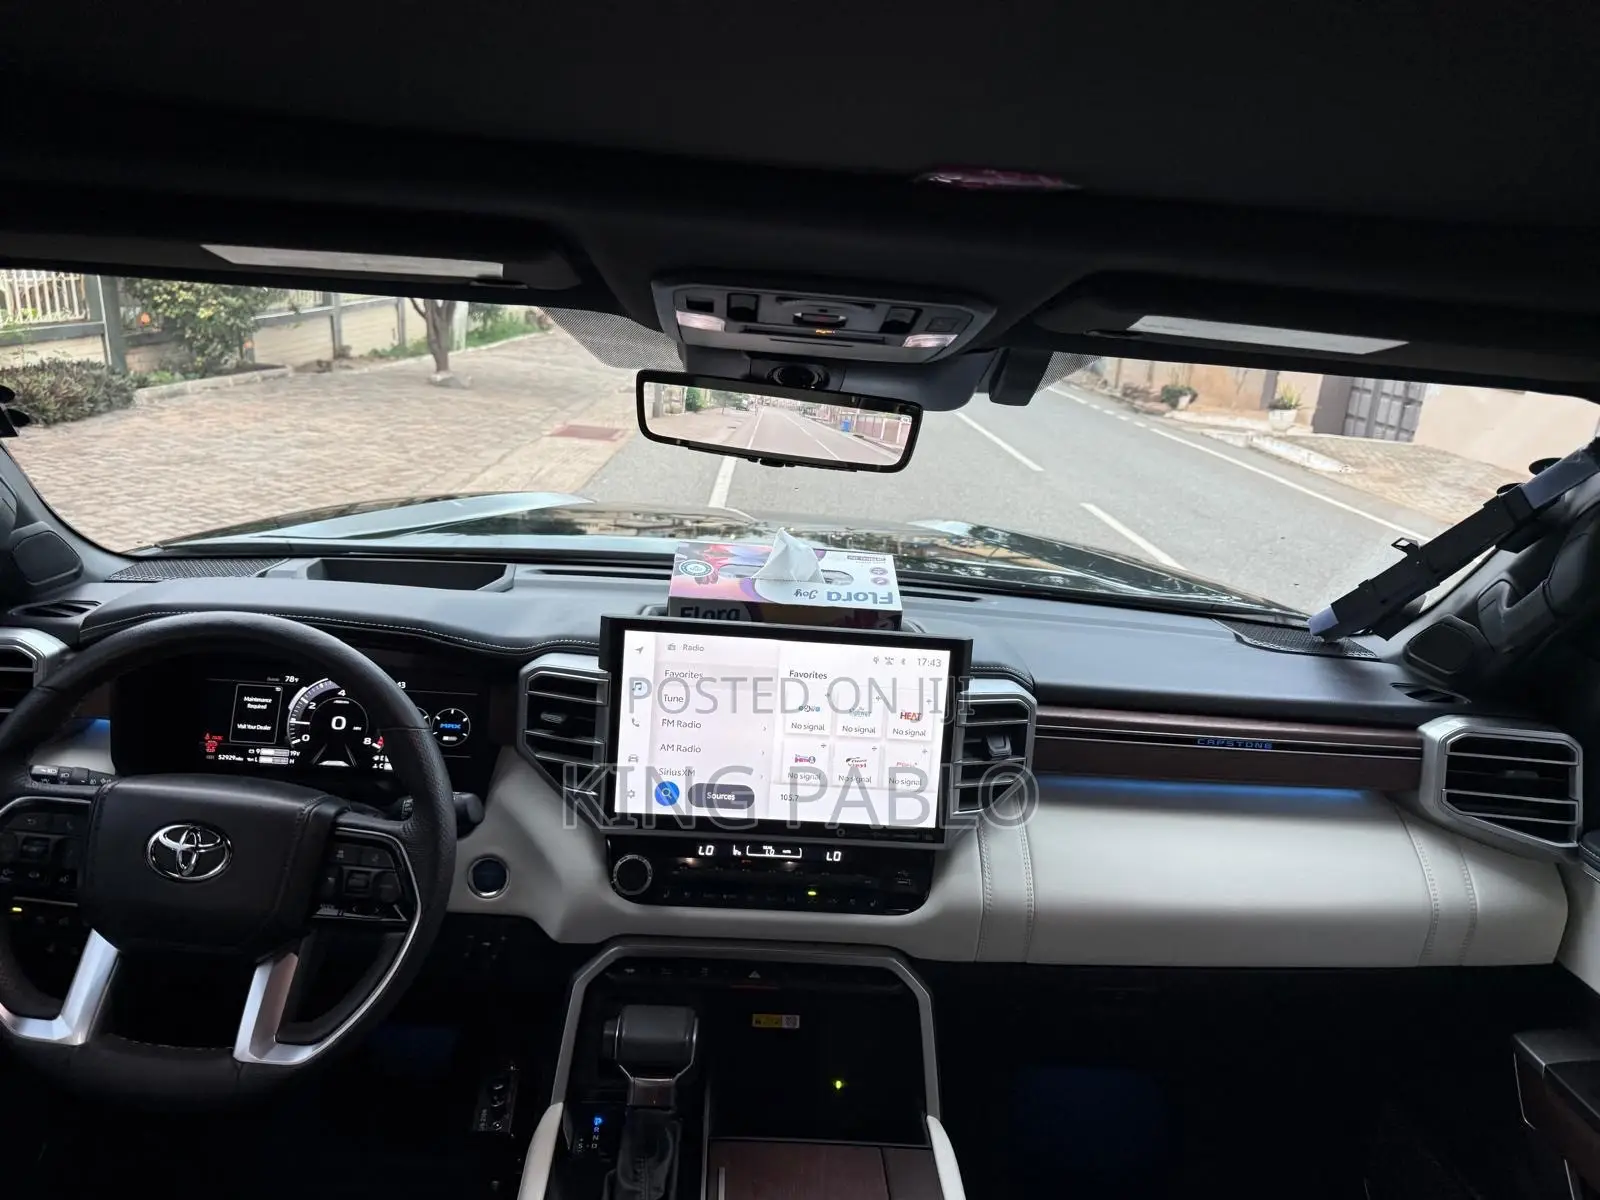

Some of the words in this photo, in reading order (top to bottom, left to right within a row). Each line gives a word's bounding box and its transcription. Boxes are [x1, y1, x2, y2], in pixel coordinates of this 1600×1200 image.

[793, 588, 819, 600] Joy
[826, 591, 894, 605] Flora
[682, 643, 705, 652] Radio
[917, 657, 942, 668] 17:43
[664, 669, 703, 680] Favorites
[789, 669, 828, 680] Favorites
[663, 694, 684, 703] Tune
[308, 701, 317, 710] 2
[899, 711, 923, 722] HEAT
[330, 715, 347, 731] 0
[661, 718, 676, 728] FM
[676, 720, 702, 729] Radio
[791, 722, 803, 730] No
[803, 723, 826, 733] signal
[842, 725, 854, 733] No
[854, 726, 876, 736] signal
[892, 728, 904, 736] No
[904, 729, 927, 739] signal
[301, 734, 311, 742] 0
[660, 743, 675, 752] AM
[676, 744, 702, 753] Radio
[1196, 738, 1273, 750] CAPSTONE
[658, 767, 696, 777] SiriusXM
[787, 771, 799, 780] No
[799, 773, 822, 783] signal
[838, 775, 848, 783] No
[848, 775, 873, 785] signal
[888, 777, 900, 786] No
[900, 779, 922, 788] signal
[706, 790, 737, 801] Sources
[780, 793, 799, 802] 105.7
[594, 1117, 603, 1126] P
